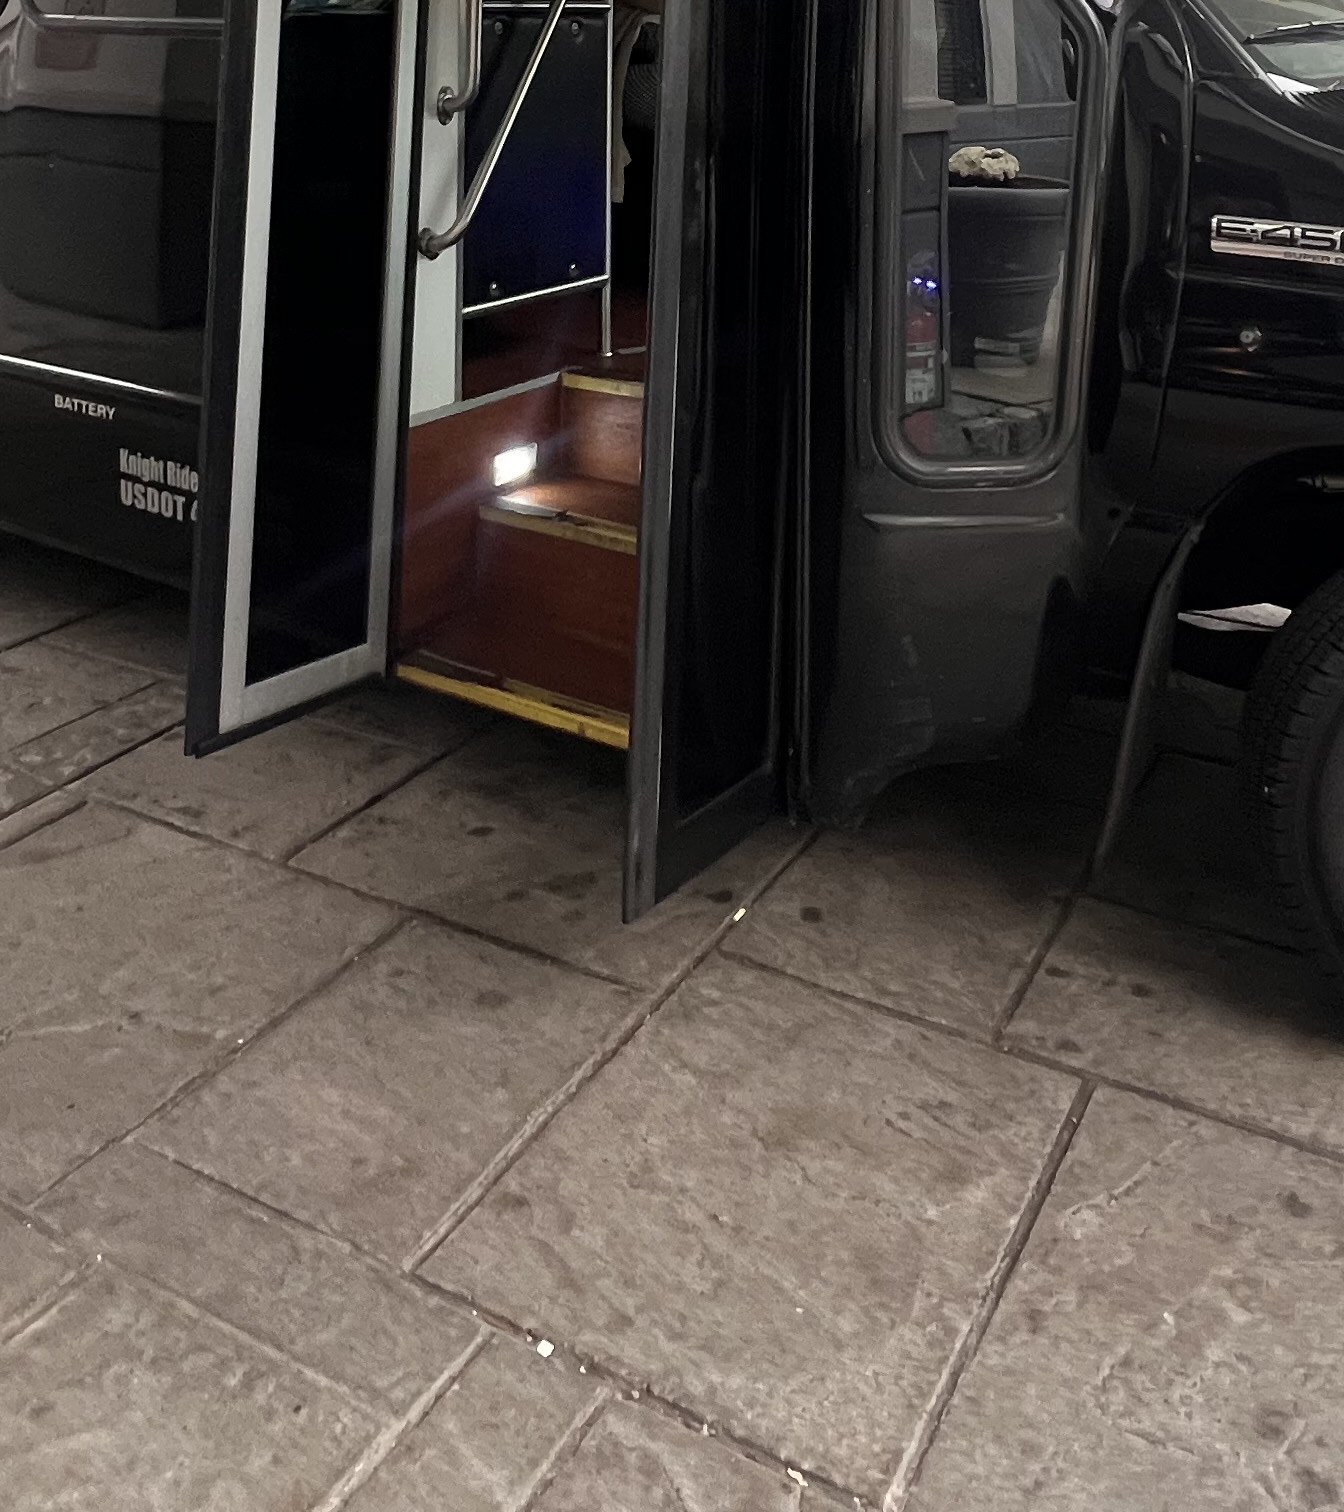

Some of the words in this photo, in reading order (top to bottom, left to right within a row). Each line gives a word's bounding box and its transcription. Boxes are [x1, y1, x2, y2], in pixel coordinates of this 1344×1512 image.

[1283, 250, 1331, 263] SUPER
[54, 393, 116, 420] BATTERY
[119, 448, 165, 484] Knight
[120, 479, 186, 522] USDOT
